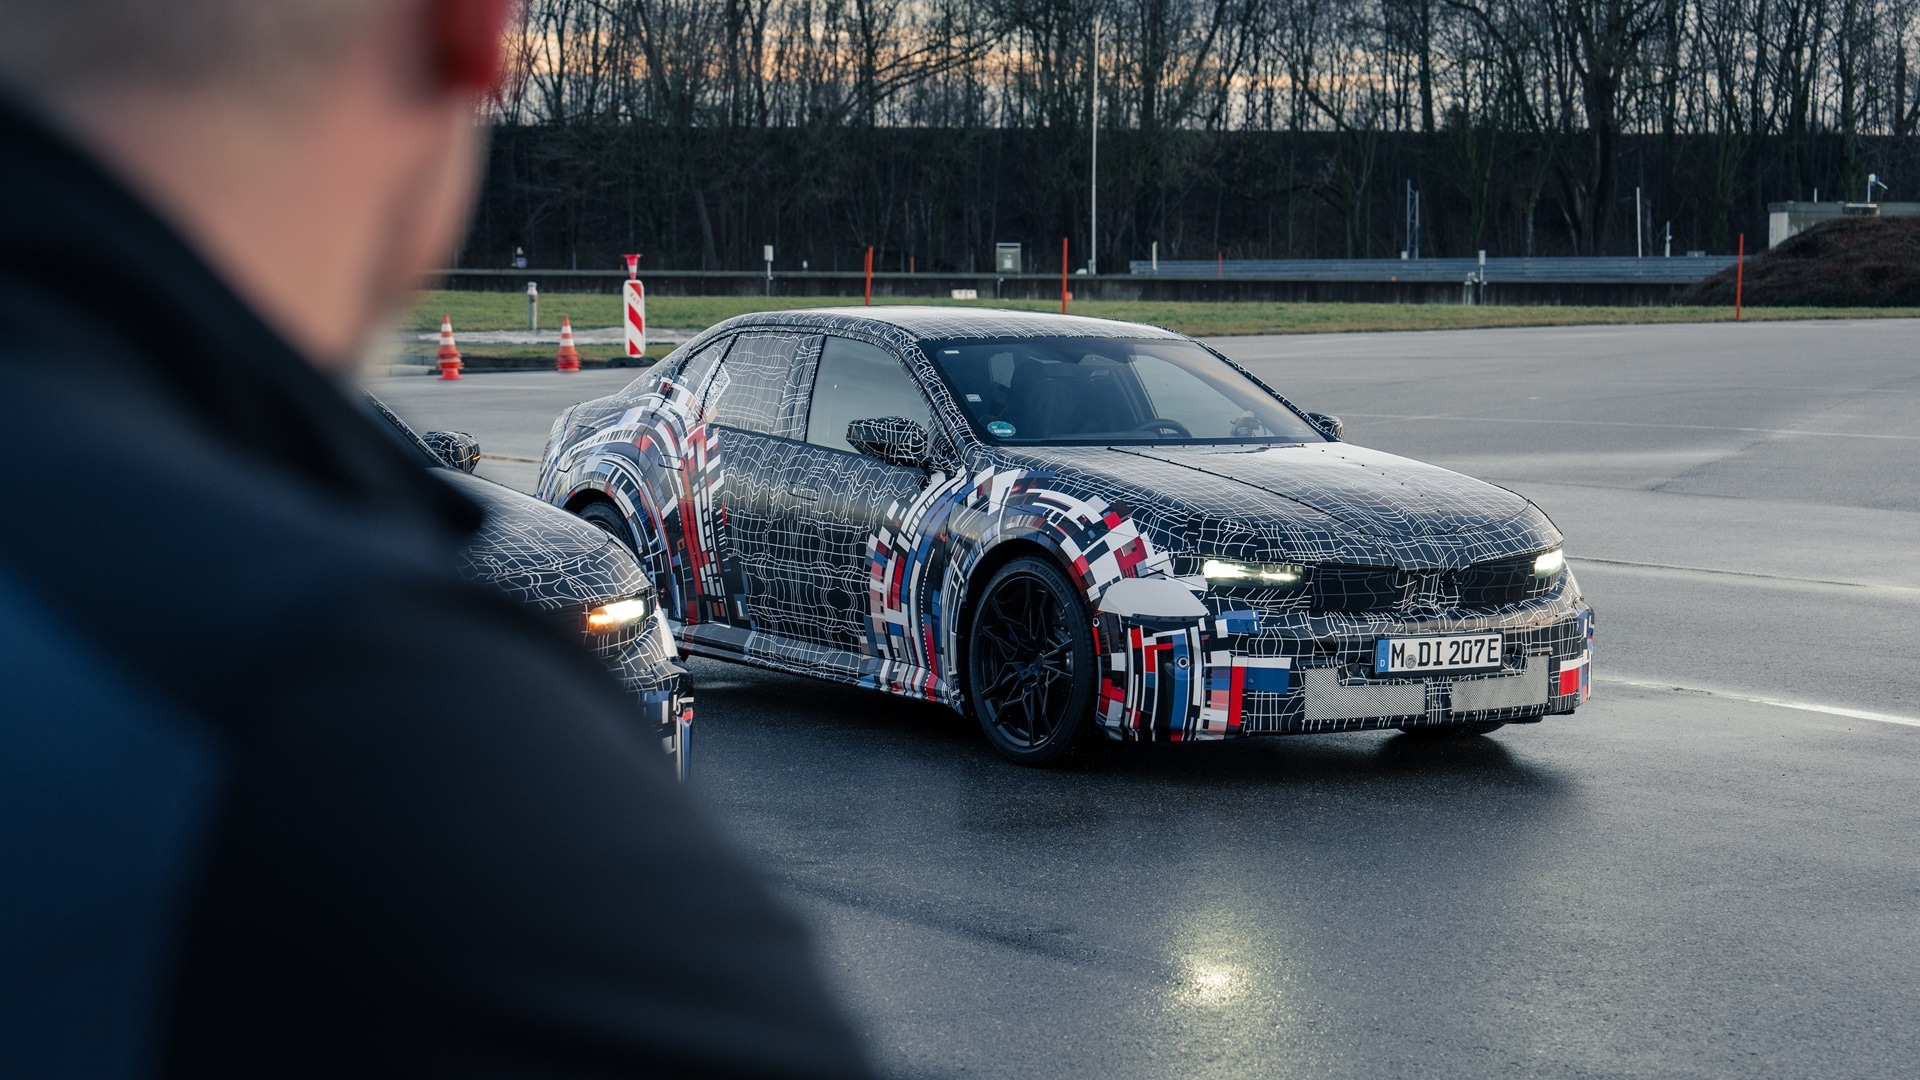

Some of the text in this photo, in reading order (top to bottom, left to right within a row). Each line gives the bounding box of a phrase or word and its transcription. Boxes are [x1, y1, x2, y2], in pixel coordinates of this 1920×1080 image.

[1036, 566, 1063, 593] MICHELIN
[1380, 659, 1386, 668] D
[1391, 638, 1499, 668] M DI 207E
